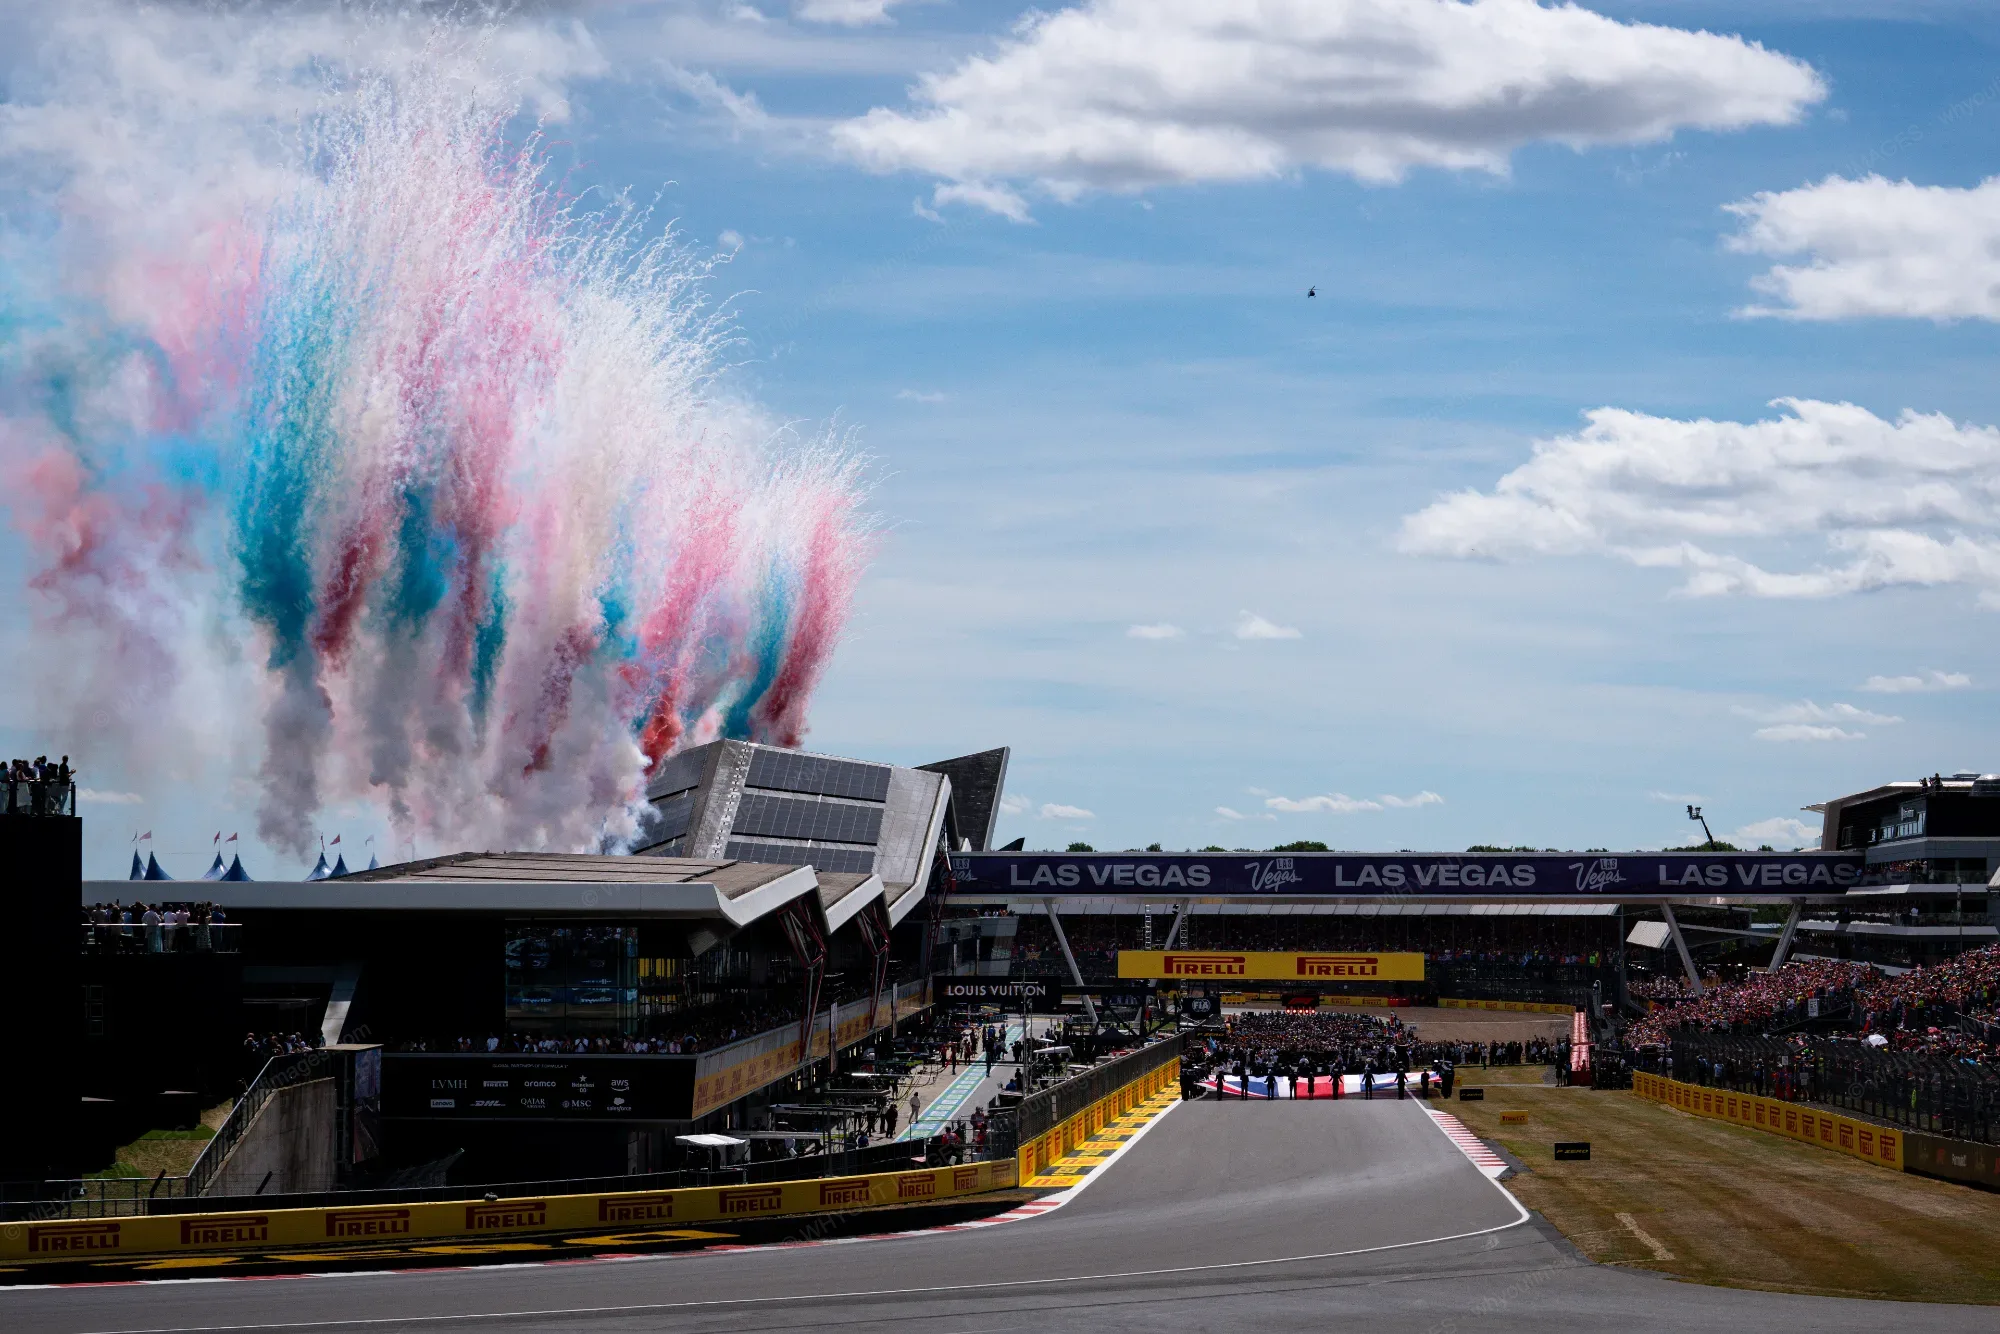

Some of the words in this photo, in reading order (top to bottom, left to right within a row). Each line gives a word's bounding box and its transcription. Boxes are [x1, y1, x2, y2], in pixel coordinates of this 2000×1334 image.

[1011, 864, 1080, 886] LAS
[1087, 864, 1211, 886] VEGAS
[1277, 859, 1292, 868] LAS
[1601, 859, 1617, 868] LAS
[1659, 864, 1728, 886] LAS
[1735, 863, 1857, 886] VEGAS
[1244, 859, 1302, 892] Vegas
[1335, 864, 1406, 887] LAS
[1412, 864, 1536, 887] VEGAS
[1568, 859, 1626, 892] Vegas
[1164, 955, 1246, 975] PIRELLI
[1296, 956, 1378, 976] PIRELLI
[947, 985, 986, 997] LOUIS
[432, 1080, 468, 1089] LVMH
[520, 1097, 546, 1105] QATAR
[606, 1105, 632, 1113] salesforce
[819, 1179, 870, 1206] PIRELLI
[898, 1173, 936, 1198] PIRELLI
[598, 1194, 674, 1222] PIRELLI
[718, 1187, 782, 1214] PIRELLI
[325, 1208, 410, 1237] PIRELLI
[465, 1201, 547, 1229] PIRELLI
[28, 1223, 121, 1252] PIRELLI
[180, 1216, 269, 1245] PIRELLI
